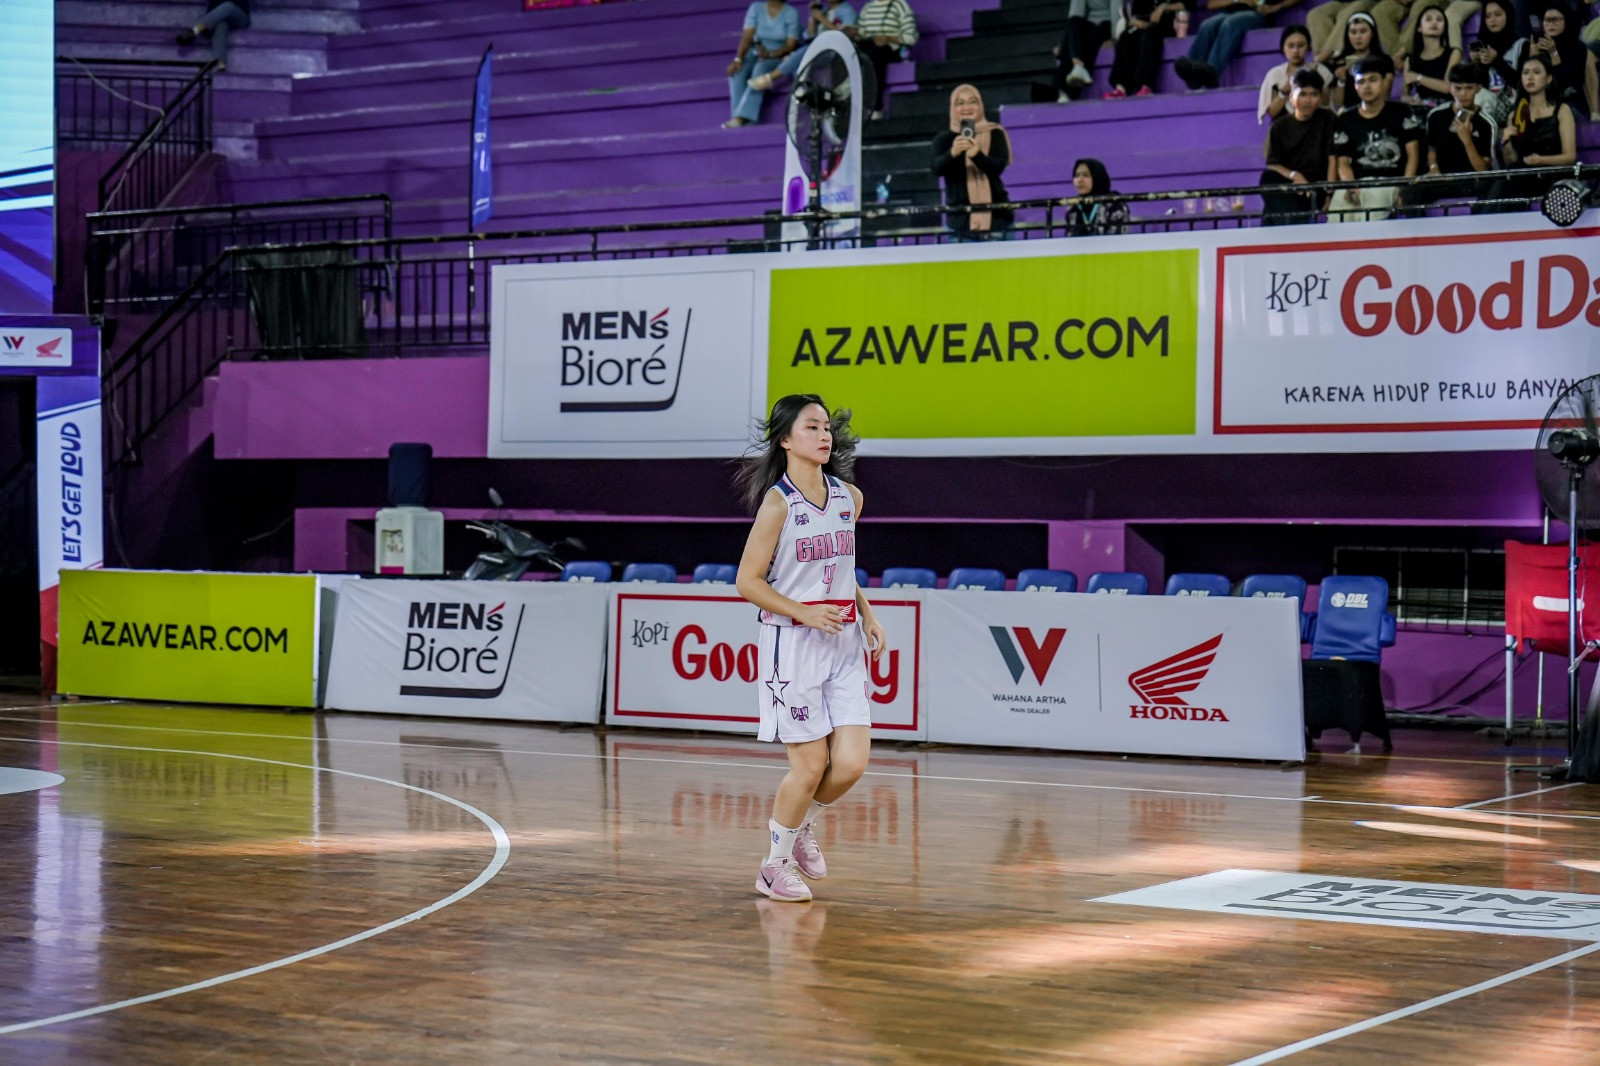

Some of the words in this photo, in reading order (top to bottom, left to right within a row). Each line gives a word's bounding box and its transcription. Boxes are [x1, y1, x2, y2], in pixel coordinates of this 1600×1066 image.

[1340, 259, 1525, 338] Good
[791, 315, 1170, 367] AZAWEAR.COM
[560, 343, 667, 387] Bioré
[1284, 384, 1366, 404] KARENA
[1373, 382, 1430, 403] HIDUP
[1439, 381, 1497, 400] PERLU
[60, 422, 83, 477] LOUD
[61, 474, 82, 516] GET
[61, 516, 82, 563] LET'S
[1345, 593, 1369, 603] DBL
[82, 620, 288, 653] AZAWEAR.COM
[402, 632, 500, 674] Bioré
[672, 624, 760, 683] Goo
[992, 694, 1033, 703] WAHANA
[1035, 695, 1067, 705] ARTHA
[1129, 705, 1230, 722] HONDA
